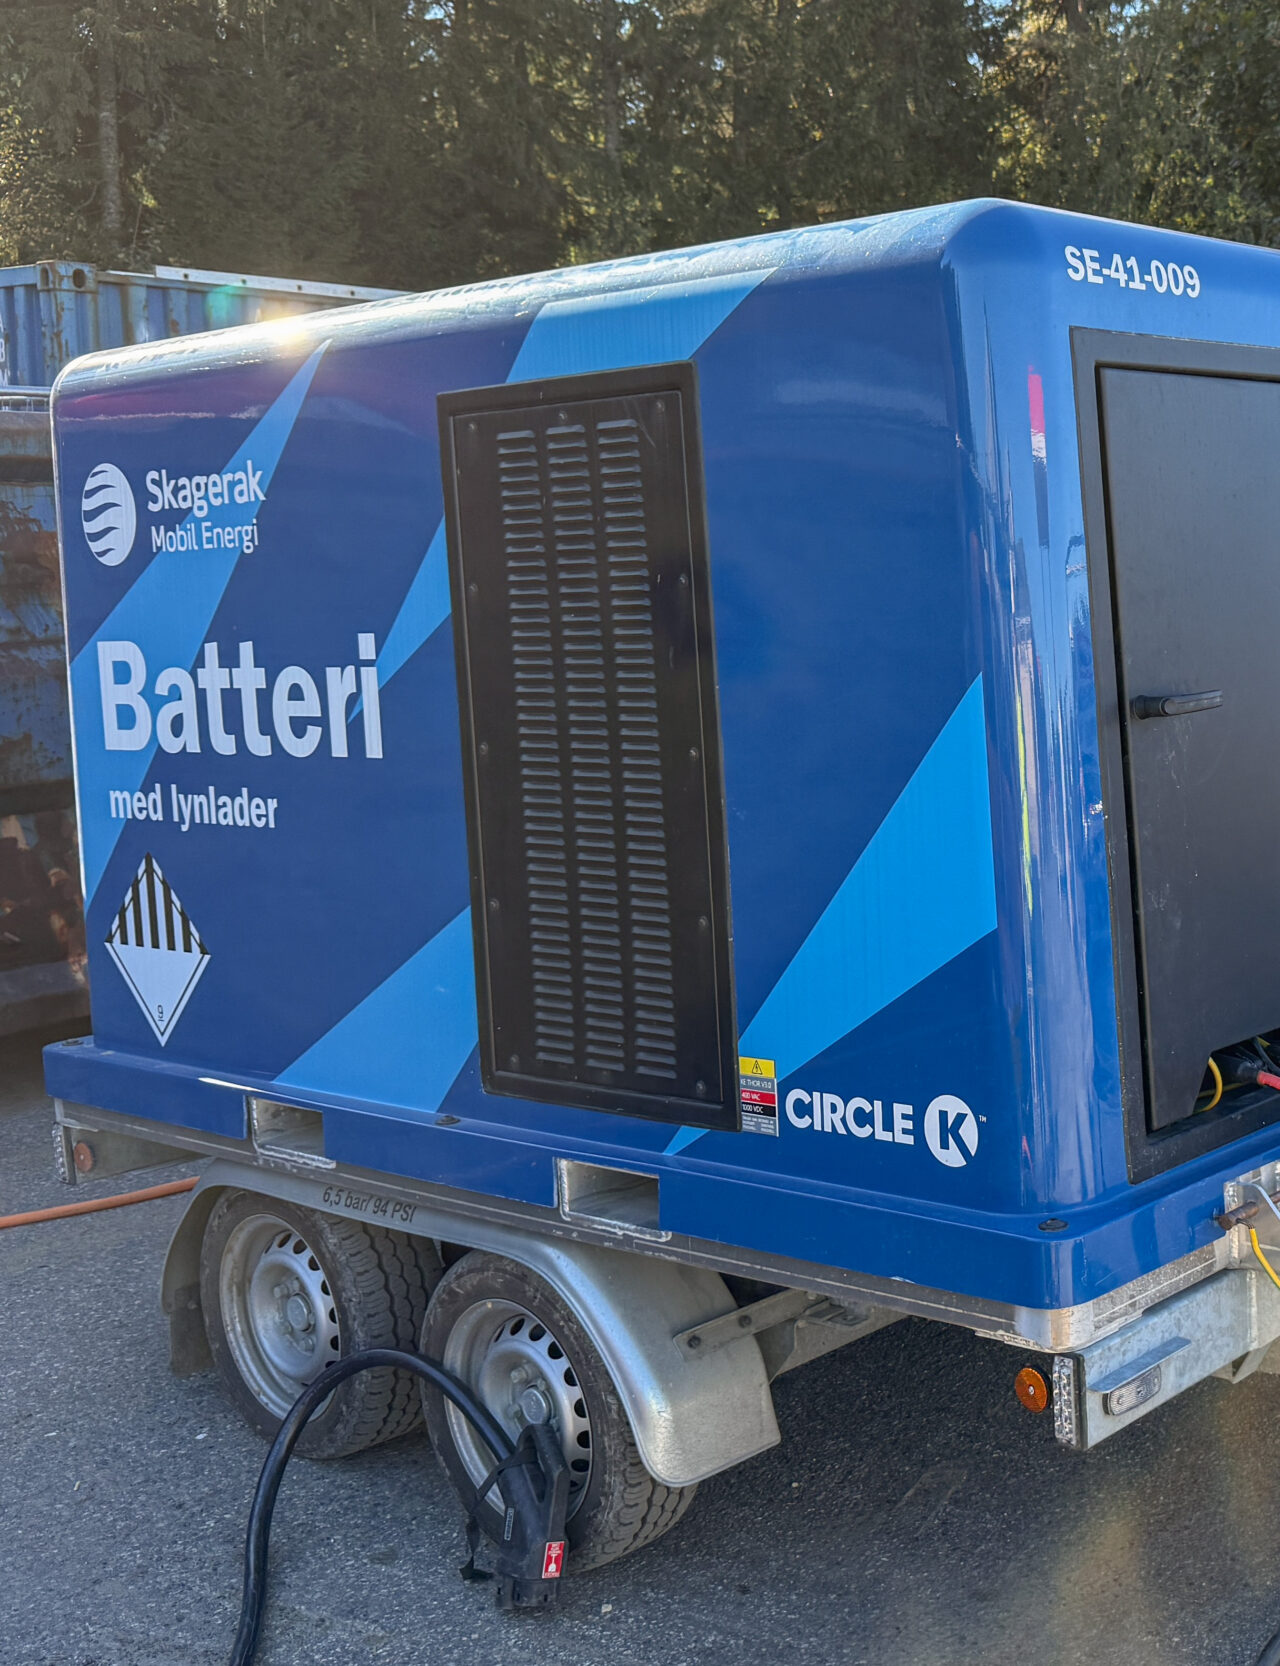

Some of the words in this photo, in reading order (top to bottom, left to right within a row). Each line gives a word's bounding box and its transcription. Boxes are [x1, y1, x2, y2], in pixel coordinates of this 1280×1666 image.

[1064, 245, 1201, 299] SE-41-009
[145, 460, 266, 518] Skagerak
[151, 523, 199, 552] Mobil
[201, 518, 259, 554] Energi
[97, 633, 383, 759] Batteri
[109, 783, 163, 821] med
[171, 784, 278, 832] lynlader
[157, 1004, 165, 1022] 9
[785, 1088, 915, 1145] CIRCLE
[323, 1186, 344, 1207] 6,5
[372, 1198, 390, 1216] 94
[391, 1202, 417, 1223] PSI
